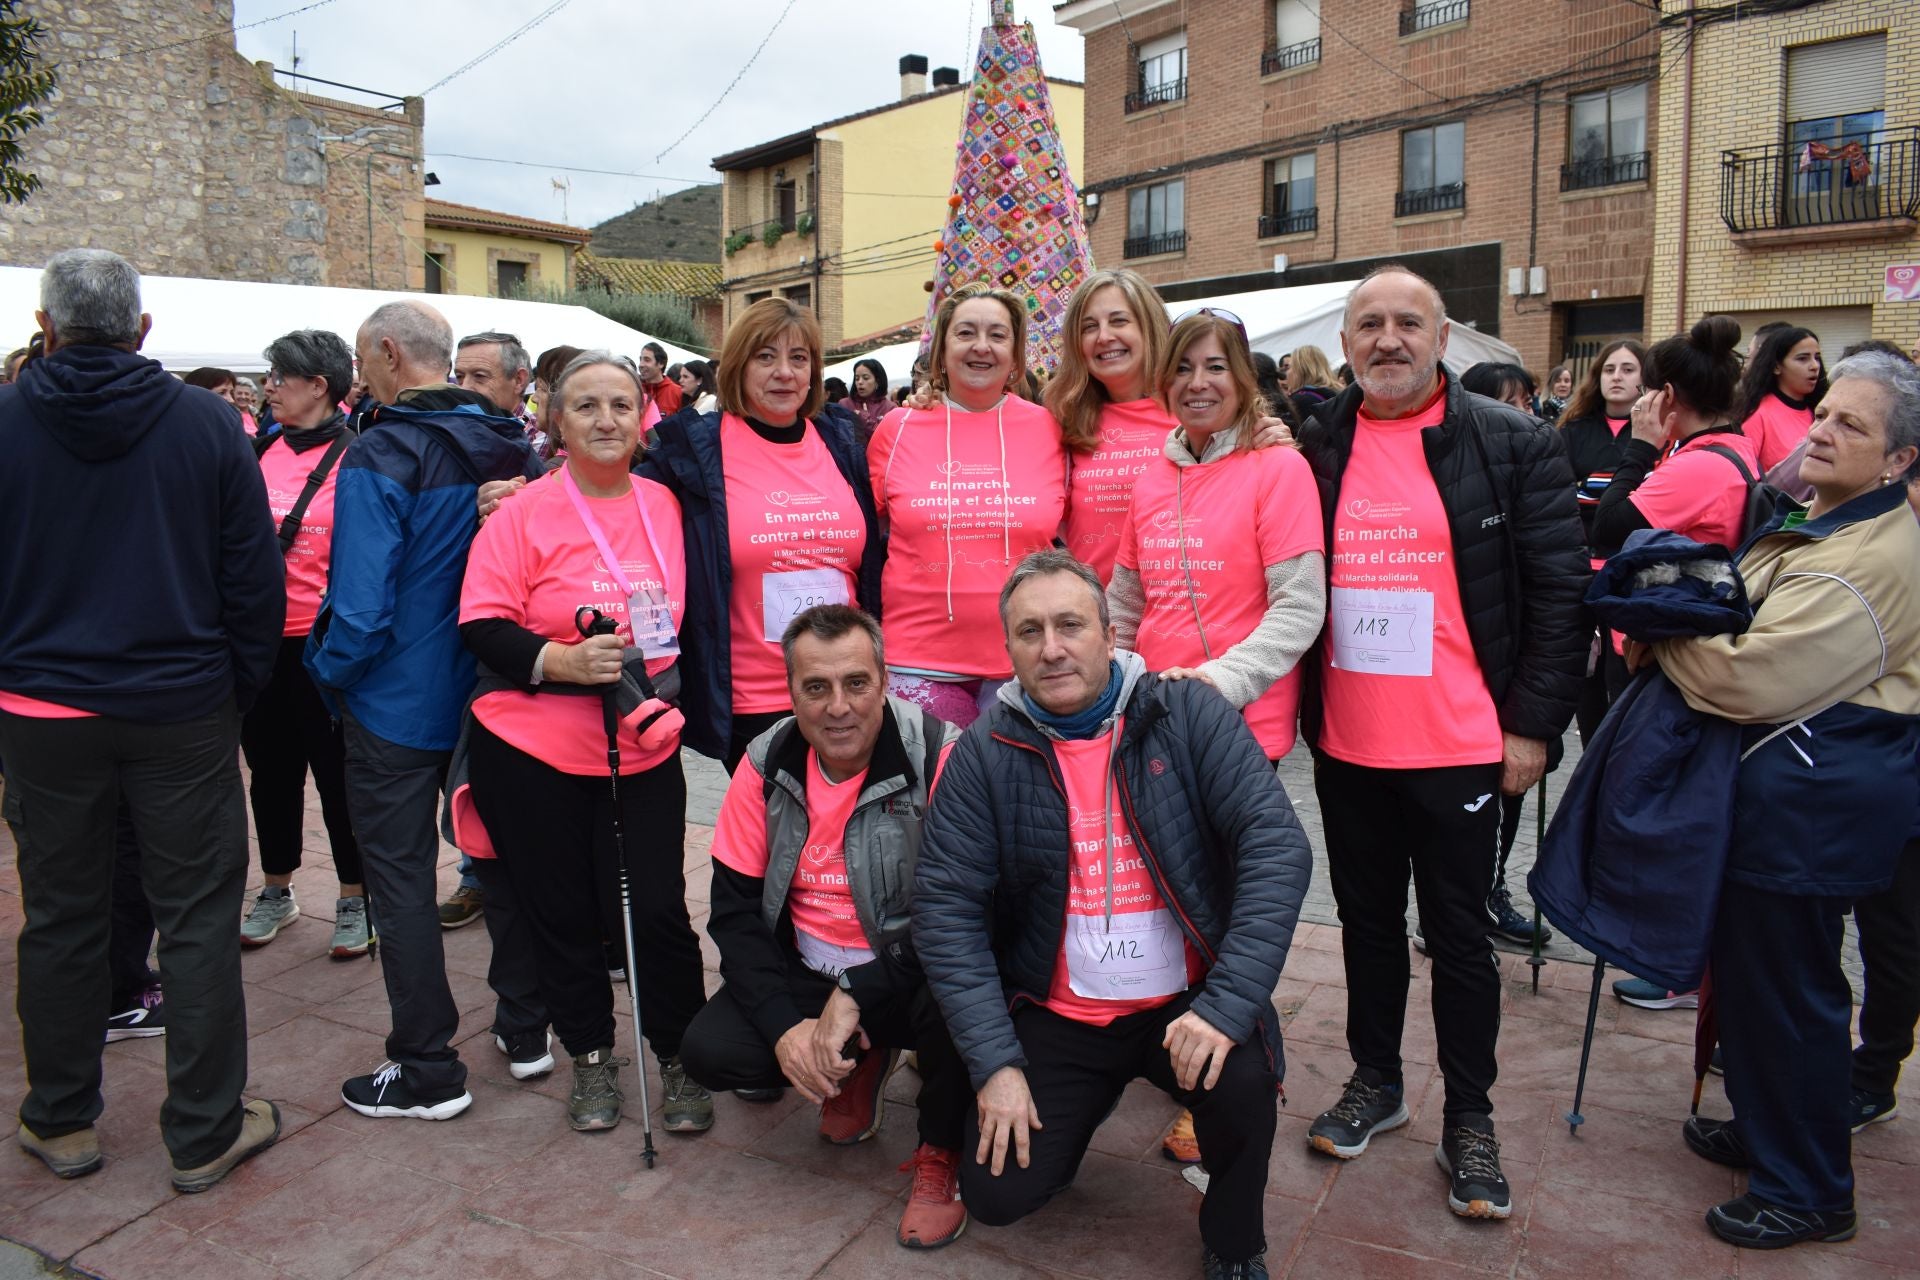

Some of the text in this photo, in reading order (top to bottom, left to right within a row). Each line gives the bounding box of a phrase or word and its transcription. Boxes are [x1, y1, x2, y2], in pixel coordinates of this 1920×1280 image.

[1092, 446, 1160, 461] En marcha
[1076, 468, 1114, 480] contra
[1118, 465, 1130, 476] el
[930, 480, 1011, 490] En marcha
[1094, 484, 1122, 492] Marcha
[910, 494, 1037, 507] contra el cáncer
[1096, 494, 1122, 502] Rincón
[765, 510, 840, 524] En marcha
[938, 512, 973, 520] Marcha
[942, 522, 973, 530] Rincón
[975, 521, 986, 529] de
[750, 528, 860, 544] contra el cáncer
[1338, 525, 1418, 541] En marcha
[1143, 536, 1155, 549] En
[782, 548, 811, 557] Marcha
[812, 546, 844, 554] solidaria
[1332, 548, 1445, 565] ontra el cáncer
[1140, 556, 1225, 571] ntra el cáncer
[1170, 578, 1201, 587] solidia
[1346, 574, 1377, 582] Marcha
[1378, 574, 1419, 582] solidaria
[592, 580, 610, 592] En
[1354, 617, 1389, 637] 118
[1074, 833, 1133, 853] marha
[1088, 860, 1102, 876] el
[1112, 858, 1146, 874] ánc
[801, 870, 849, 885] En mar
[1100, 899, 1106, 908] d
[1114, 893, 1152, 906] Olivedo
[1100, 940, 1145, 964] 112
